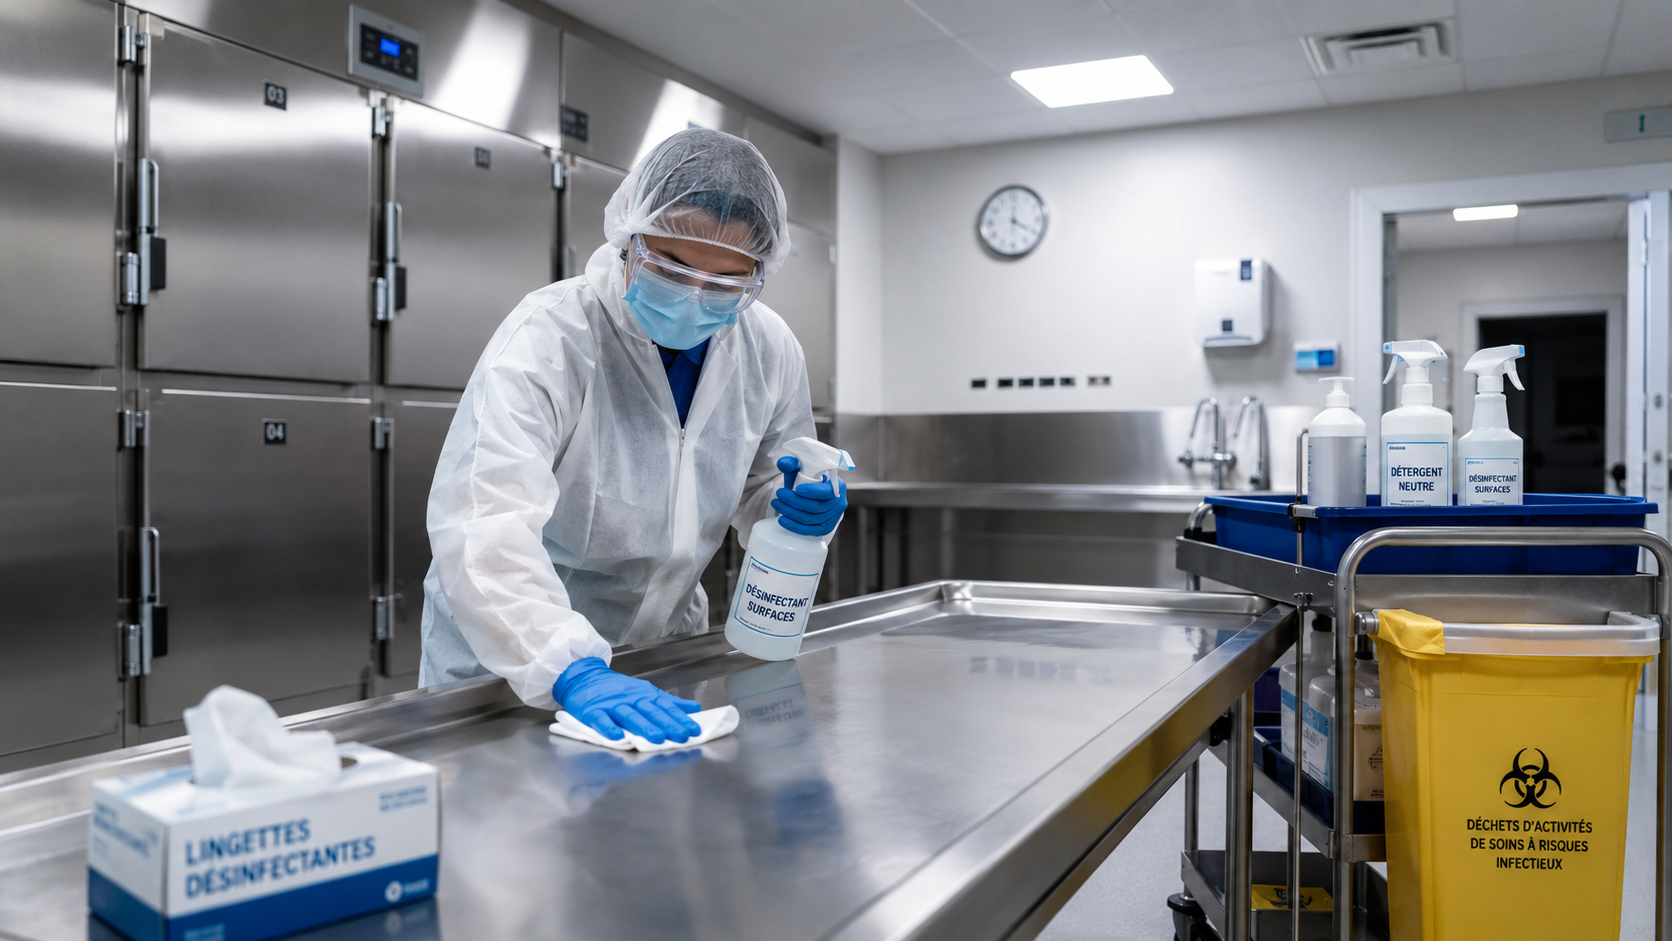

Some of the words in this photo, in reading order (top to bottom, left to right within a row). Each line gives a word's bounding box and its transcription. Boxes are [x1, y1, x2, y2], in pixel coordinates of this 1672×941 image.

[267, 86, 285, 104] 03
[266, 423, 284, 441] 04
[1391, 465, 1443, 477] DÉTERGENT
[1468, 473, 1517, 483] DÉSINFECTANT
[1399, 481, 1435, 492] NEUTRE
[745, 583, 809, 608] DÉSINFECTANT
[747, 600, 796, 622] SURFACES
[1467, 816, 1520, 832] DÉCHETS
[1523, 819, 1593, 834] D'ACTIVITÉS
[185, 818, 311, 867] LINGETTES
[1470, 837, 1486, 850] DE
[1489, 838, 1525, 851] SOINS
[1527, 836, 1536, 851] À
[1539, 839, 1589, 853] RISQUES
[185, 835, 377, 899] DÉSINFECTANTES
[1496, 857, 1563, 870] INFECTIEUX
